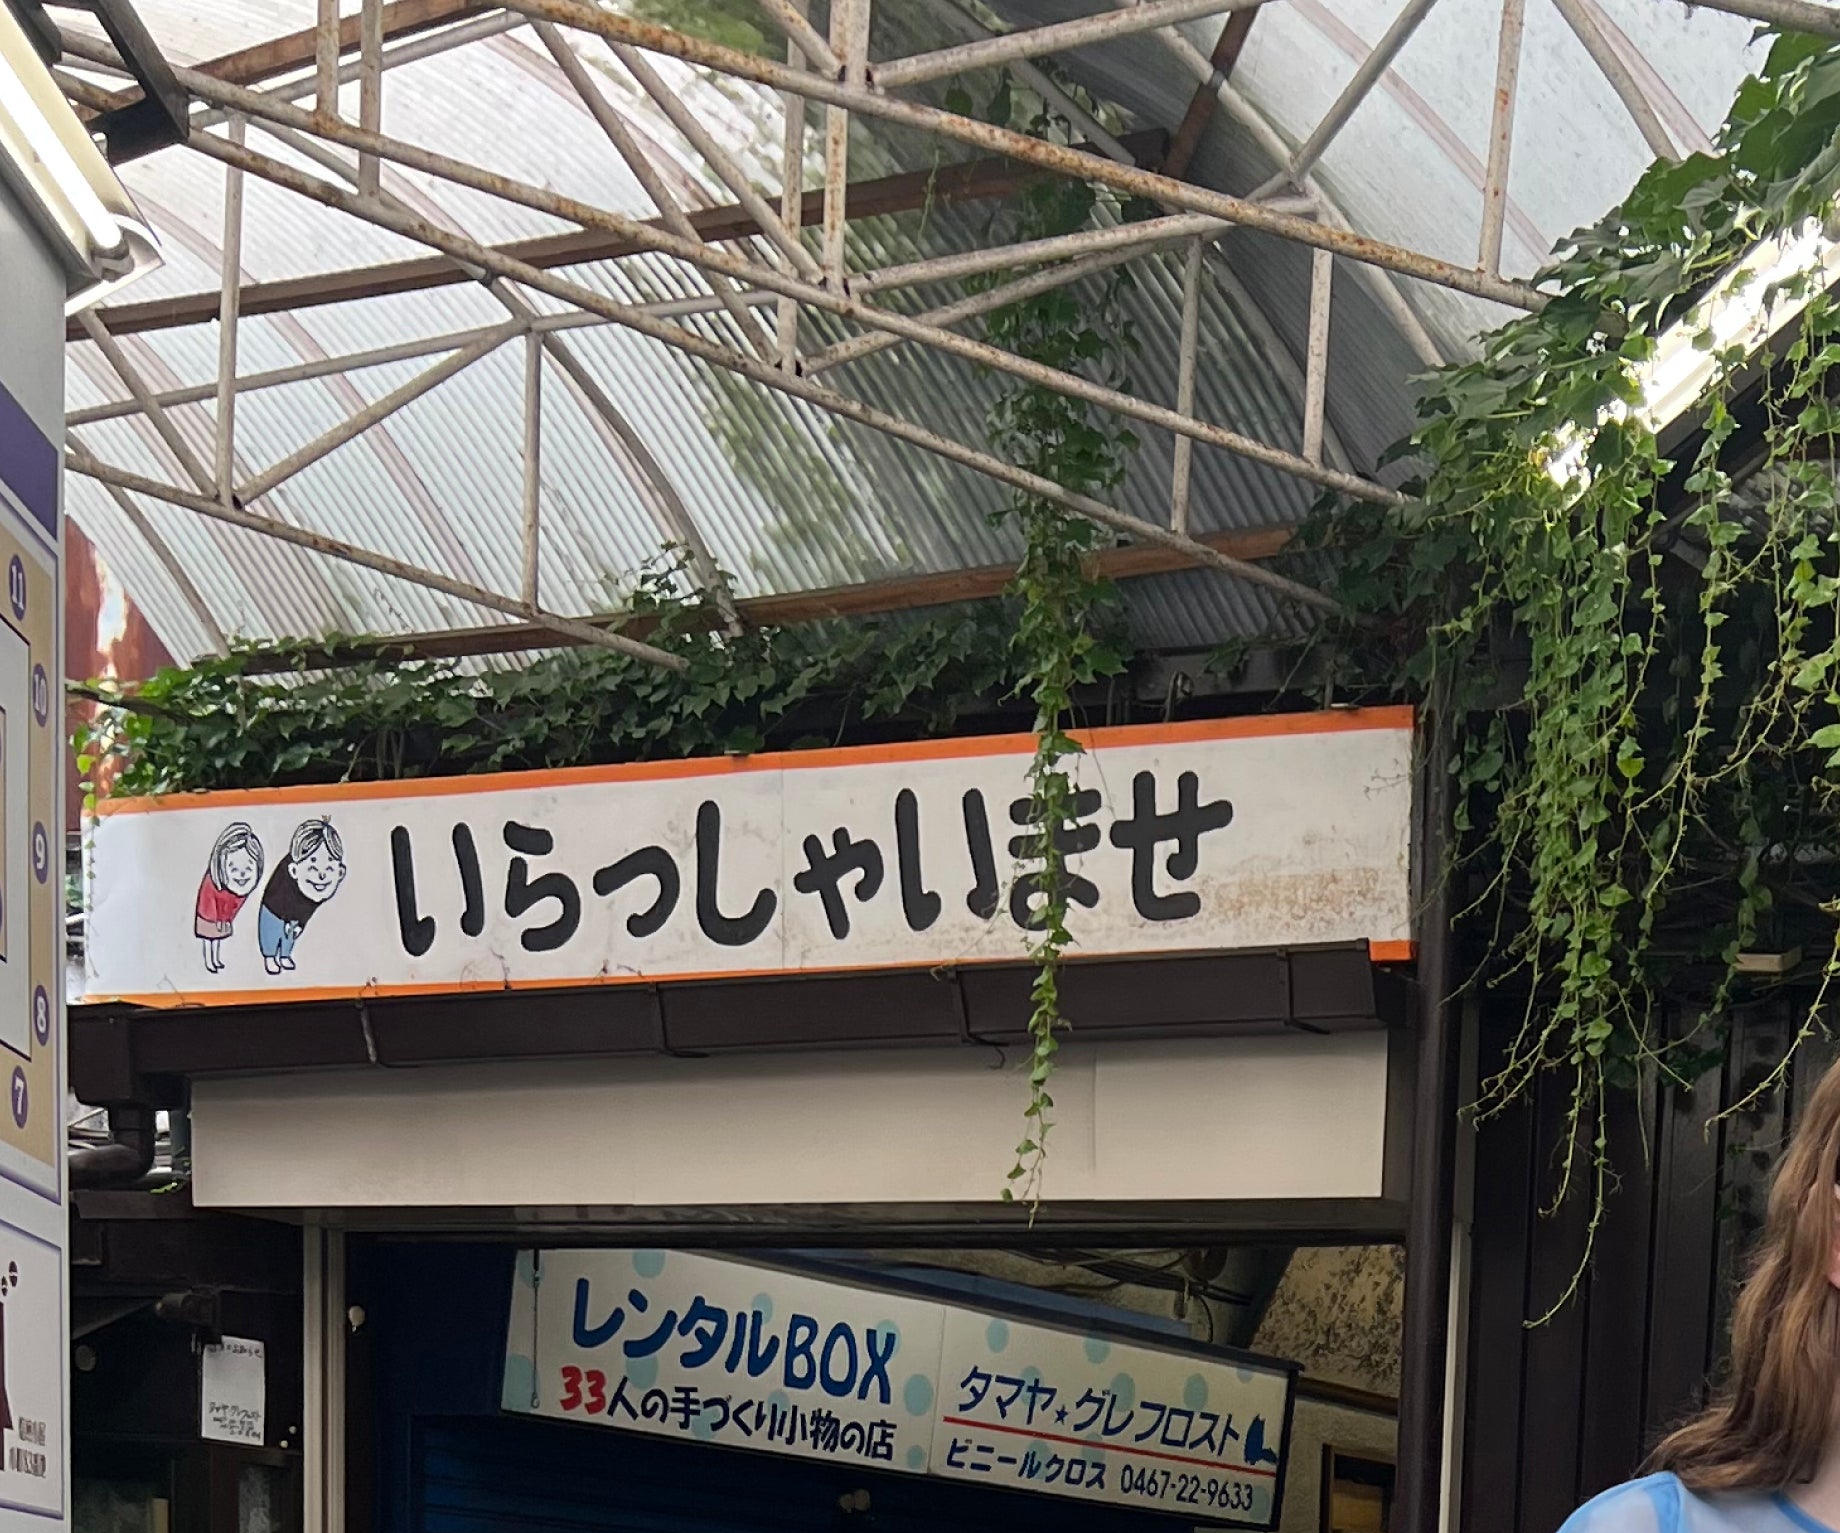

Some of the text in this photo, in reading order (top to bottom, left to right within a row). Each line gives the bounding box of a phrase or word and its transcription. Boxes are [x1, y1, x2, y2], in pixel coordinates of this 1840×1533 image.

[10, 564, 25, 612] 11
[33, 673, 48, 711] 10
[35, 841, 46, 870] 9
[393, 769, 1234, 956] いらっしゃいませ
[36, 995, 46, 1034] 8
[14, 1076, 25, 1115] 7
[571, 1276, 898, 1405] レンタルBOX
[558, 1364, 898, 1463] 33人の手づくり小物の店
[947, 1439, 1255, 1513] ビニールクロス 0467-22-9633
